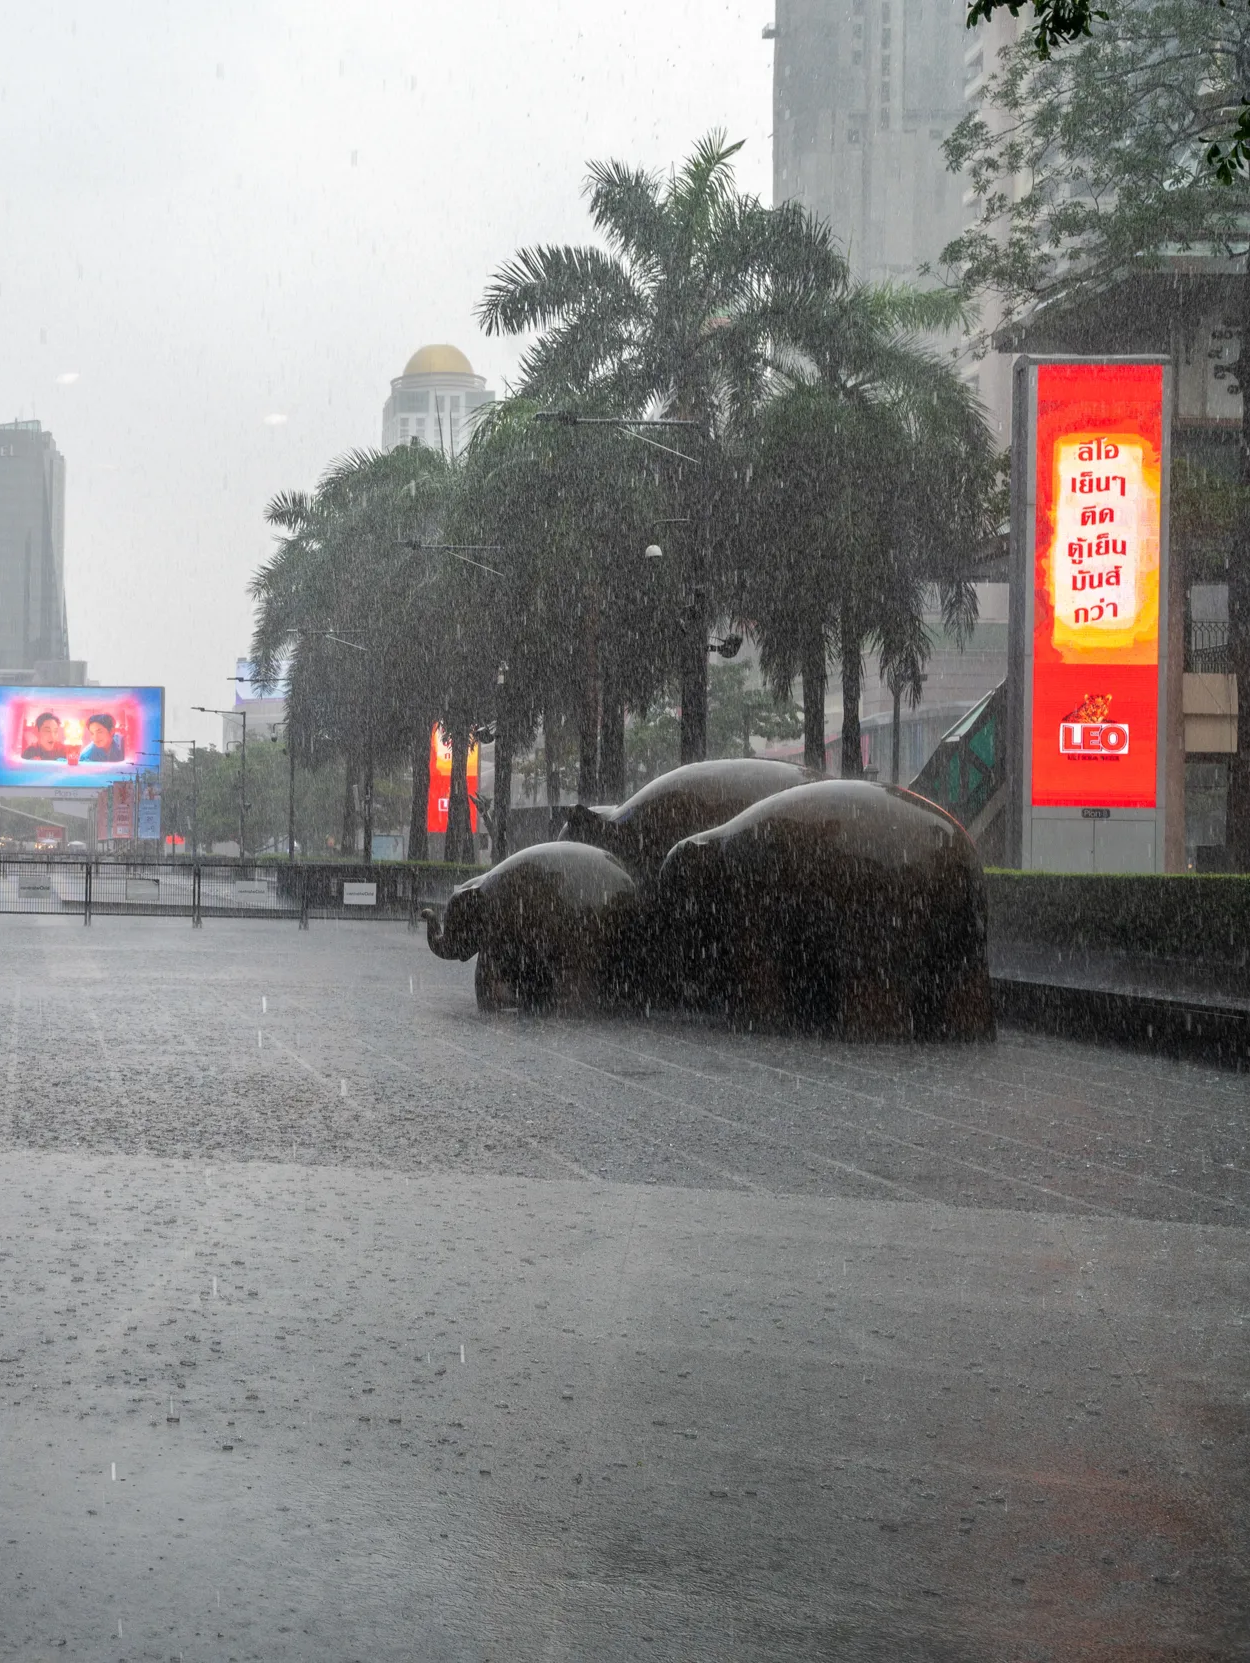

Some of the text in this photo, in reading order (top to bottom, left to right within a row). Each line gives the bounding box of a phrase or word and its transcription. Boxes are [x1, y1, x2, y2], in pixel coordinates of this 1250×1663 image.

[1078, 437, 1119, 462] ลีโอ
[1071, 471, 1126, 497] เย็นๆ
[1080, 505, 1114, 526] ติด
[1067, 532, 1127, 565] ตู้เย็น
[1071, 565, 1122, 591] มันส์
[1074, 598, 1118, 623] กว่า
[1061, 724, 1128, 753] LEO
